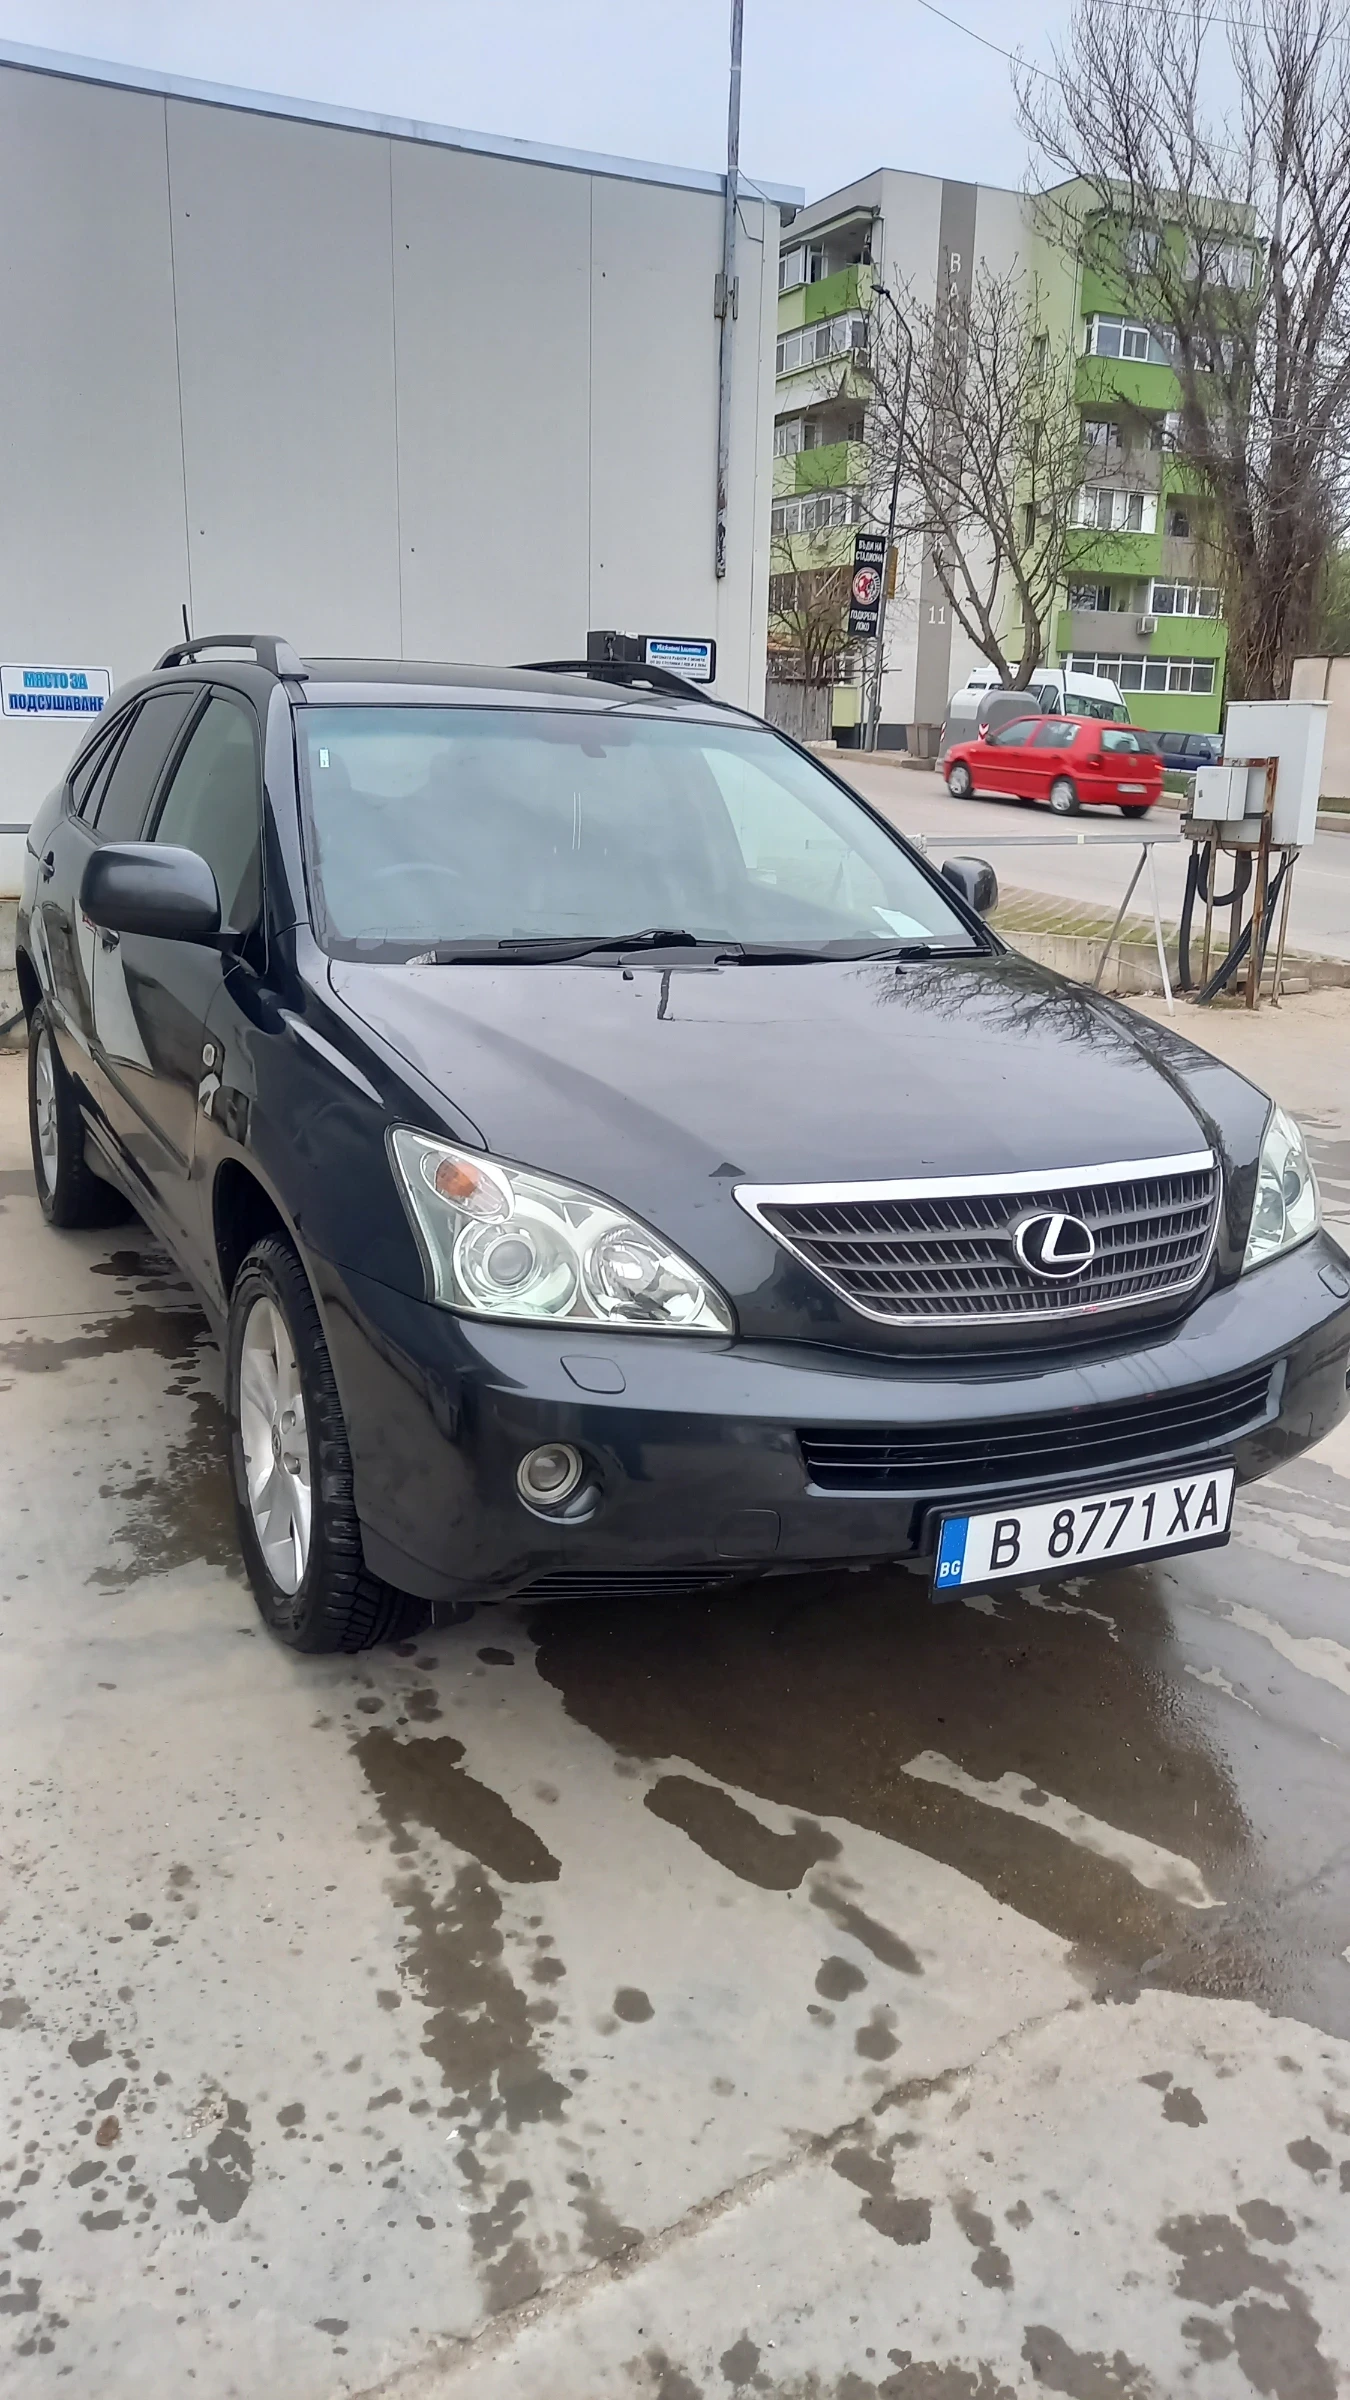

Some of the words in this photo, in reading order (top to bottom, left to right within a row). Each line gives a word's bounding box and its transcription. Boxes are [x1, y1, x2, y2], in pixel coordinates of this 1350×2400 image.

[928, 605, 946, 624] 11
[23, 671, 69, 689] МЯСТО
[69, 673, 89, 690] ЗА
[8, 693, 104, 712] ПОДСУШАВАНЕ
[939, 1561, 961, 1578] BG
[989, 1518, 1021, 1571] B
[1048, 1491, 1157, 1559] 8771
[1166, 1479, 1219, 1537] XA
